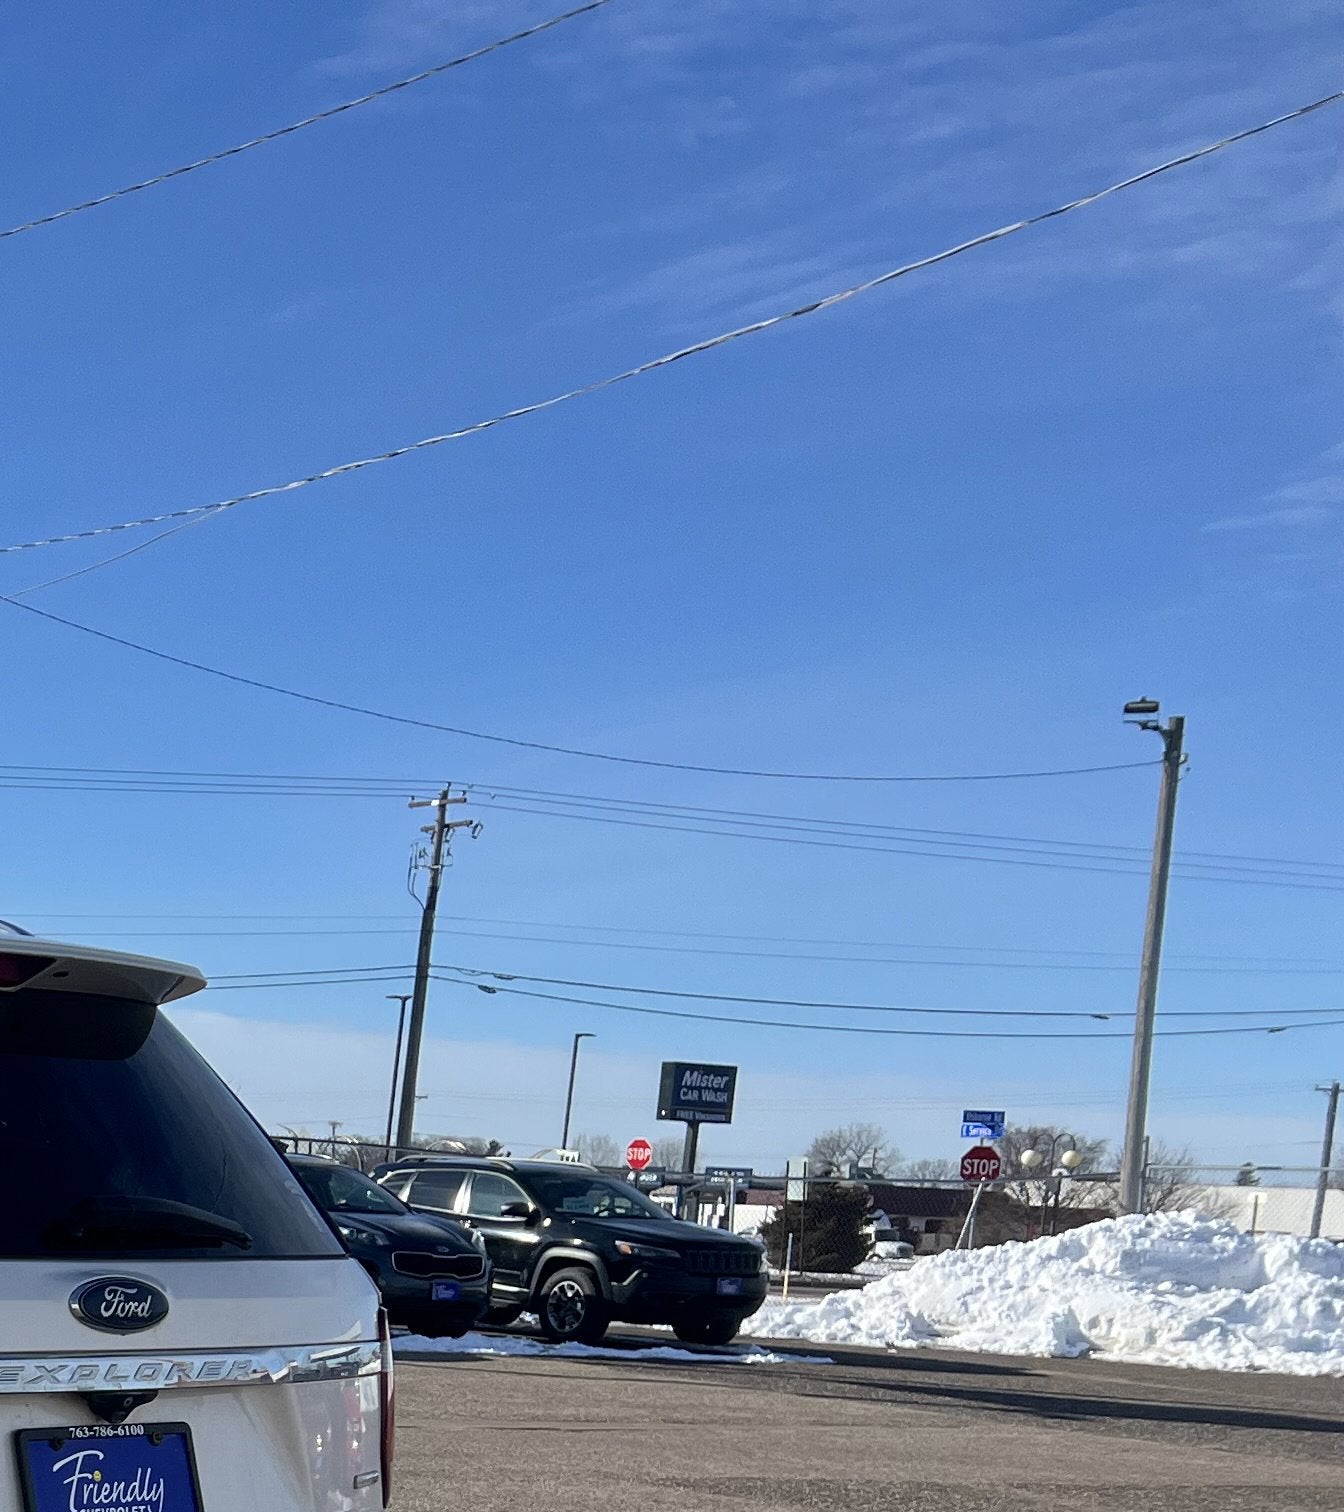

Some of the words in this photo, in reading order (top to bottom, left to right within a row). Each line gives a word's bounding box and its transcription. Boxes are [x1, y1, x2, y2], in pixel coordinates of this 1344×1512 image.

[682, 1070, 729, 1088] Mister
[680, 1088, 698, 1100] CAR
[702, 1089, 728, 1102] WASH
[627, 1147, 651, 1161] STOP
[962, 1158, 999, 1176] STOP
[100, 1286, 152, 1318] Ford
[69, 1424, 145, 1439] 763-786-6100
